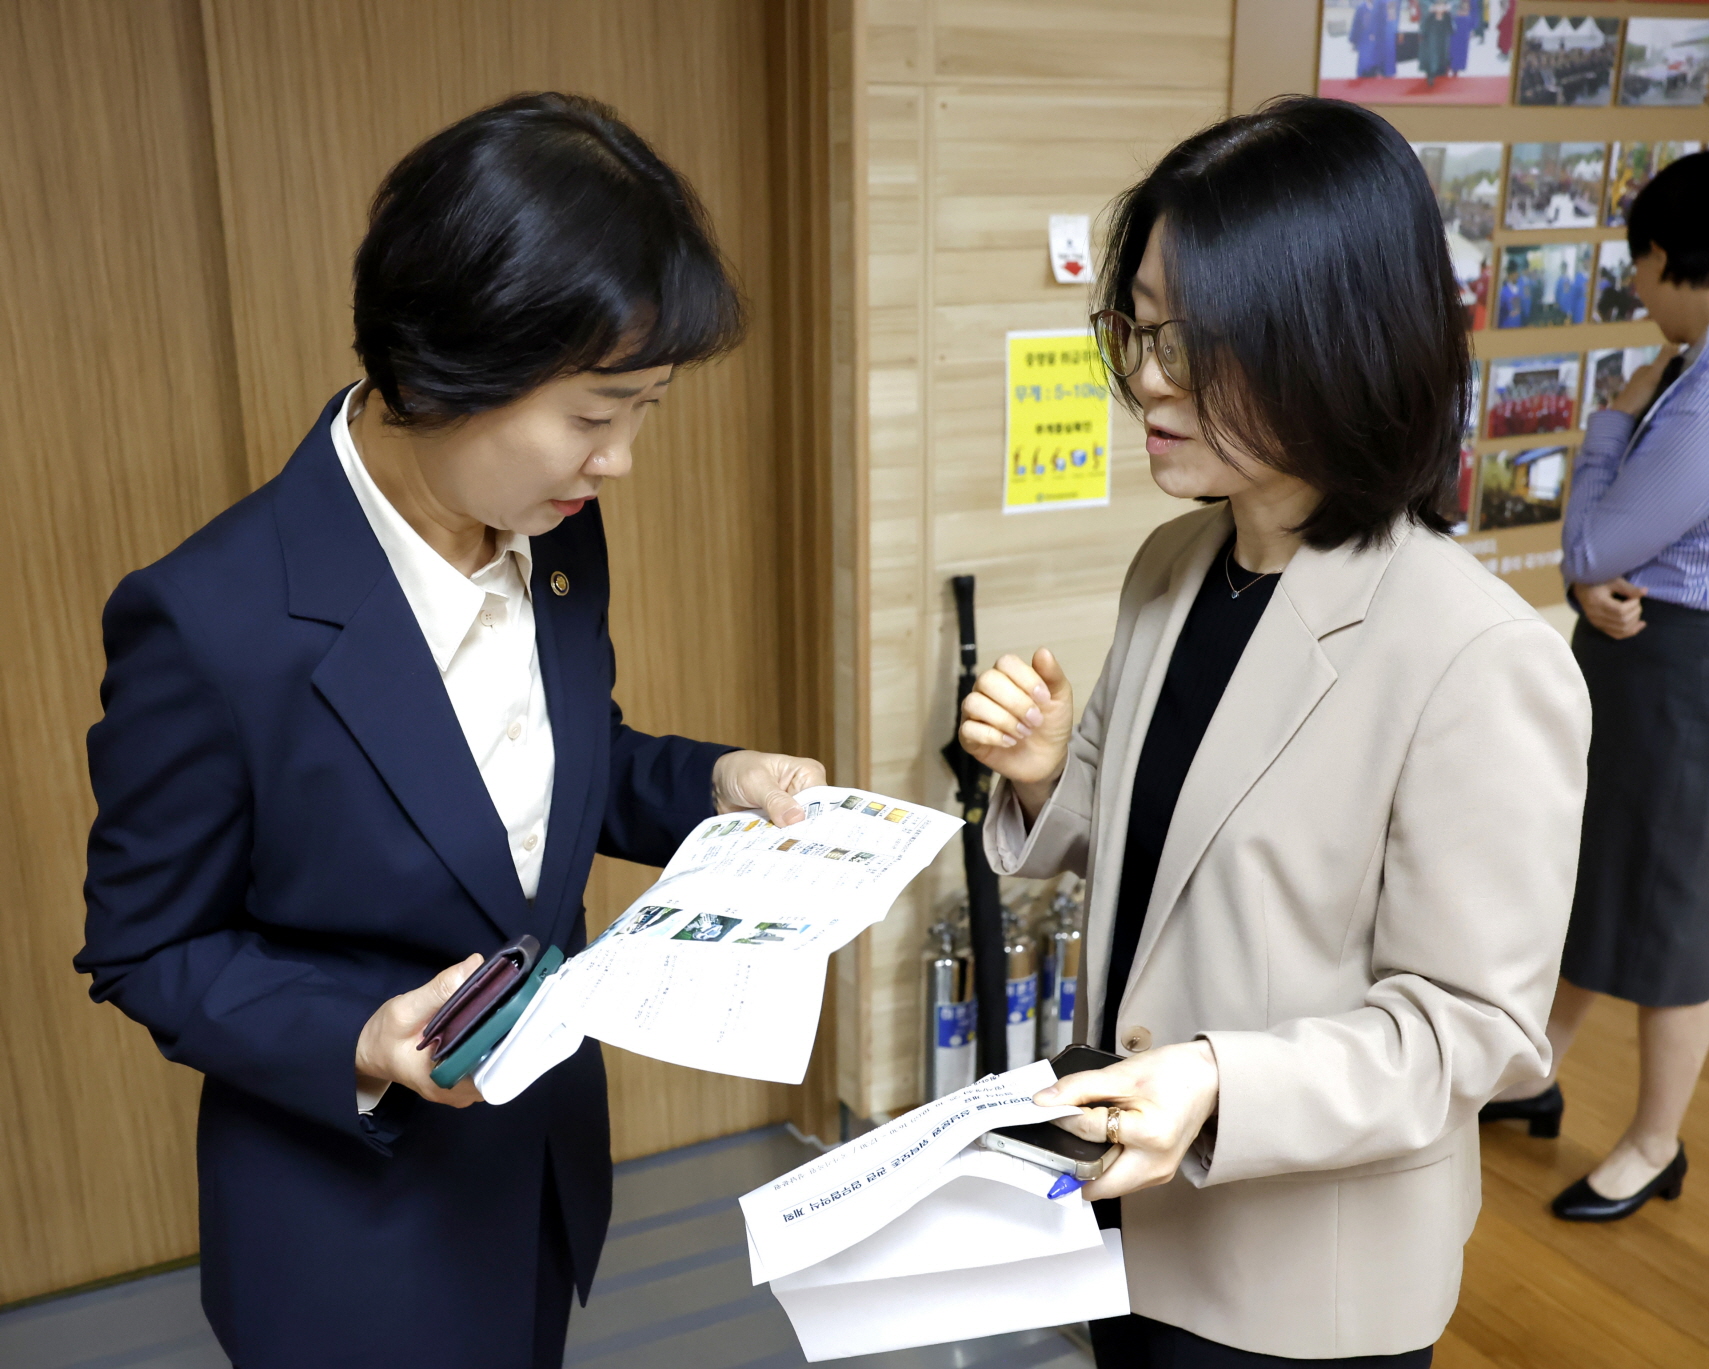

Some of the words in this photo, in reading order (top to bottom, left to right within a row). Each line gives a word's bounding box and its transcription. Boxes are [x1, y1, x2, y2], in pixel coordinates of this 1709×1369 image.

[865, 1166, 888, 1183] 관련
[809, 1180, 862, 1211] 업무협약식
[782, 1206, 806, 1223] 계획
